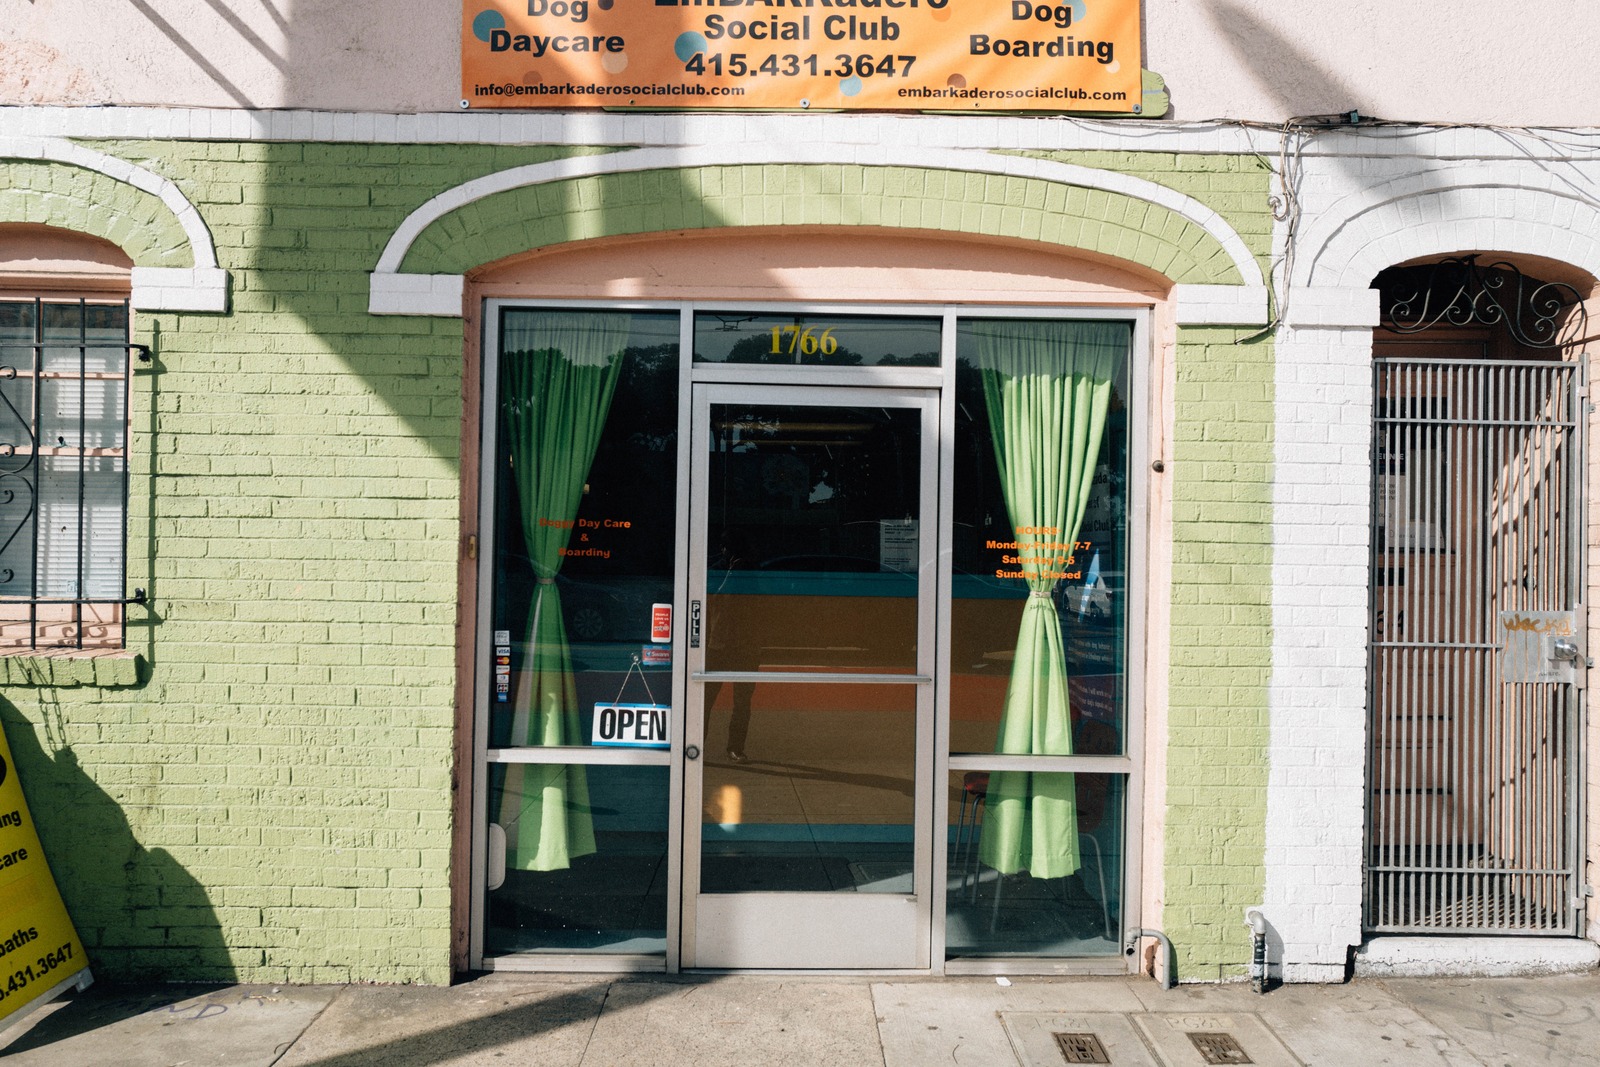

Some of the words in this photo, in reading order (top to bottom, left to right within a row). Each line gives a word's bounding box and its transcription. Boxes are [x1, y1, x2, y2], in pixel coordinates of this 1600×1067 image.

[527, 0, 588, 22] Dog
[1012, 0, 1072, 28] Dog
[703, 14, 810, 40] Social
[823, 15, 900, 41] Club
[491, 30, 625, 57] Daycare
[969, 34, 1114, 63] Boarding
[685, 53, 917, 78] 415.431.3647
[475, 83, 745, 96] info@embarkaderosocialclub.com
[898, 87, 1127, 101] embarkaderosocialclub.com
[768, 324, 838, 355] 1766
[539, 518, 575, 529] Doggy
[579, 519, 600, 529] Day
[604, 519, 631, 529] Care
[580, 533, 589, 542] &
[986, 540, 1070, 551] Monday-Friday
[1074, 541, 1092, 551] 7-7
[558, 548, 611, 558] Boarding
[1002, 555, 1054, 566] Saturday
[1057, 556, 1075, 565] 9-5
[996, 569, 1038, 580] Sunday
[1041, 570, 1081, 579] Closed
[692, 603, 700, 636] PULL
